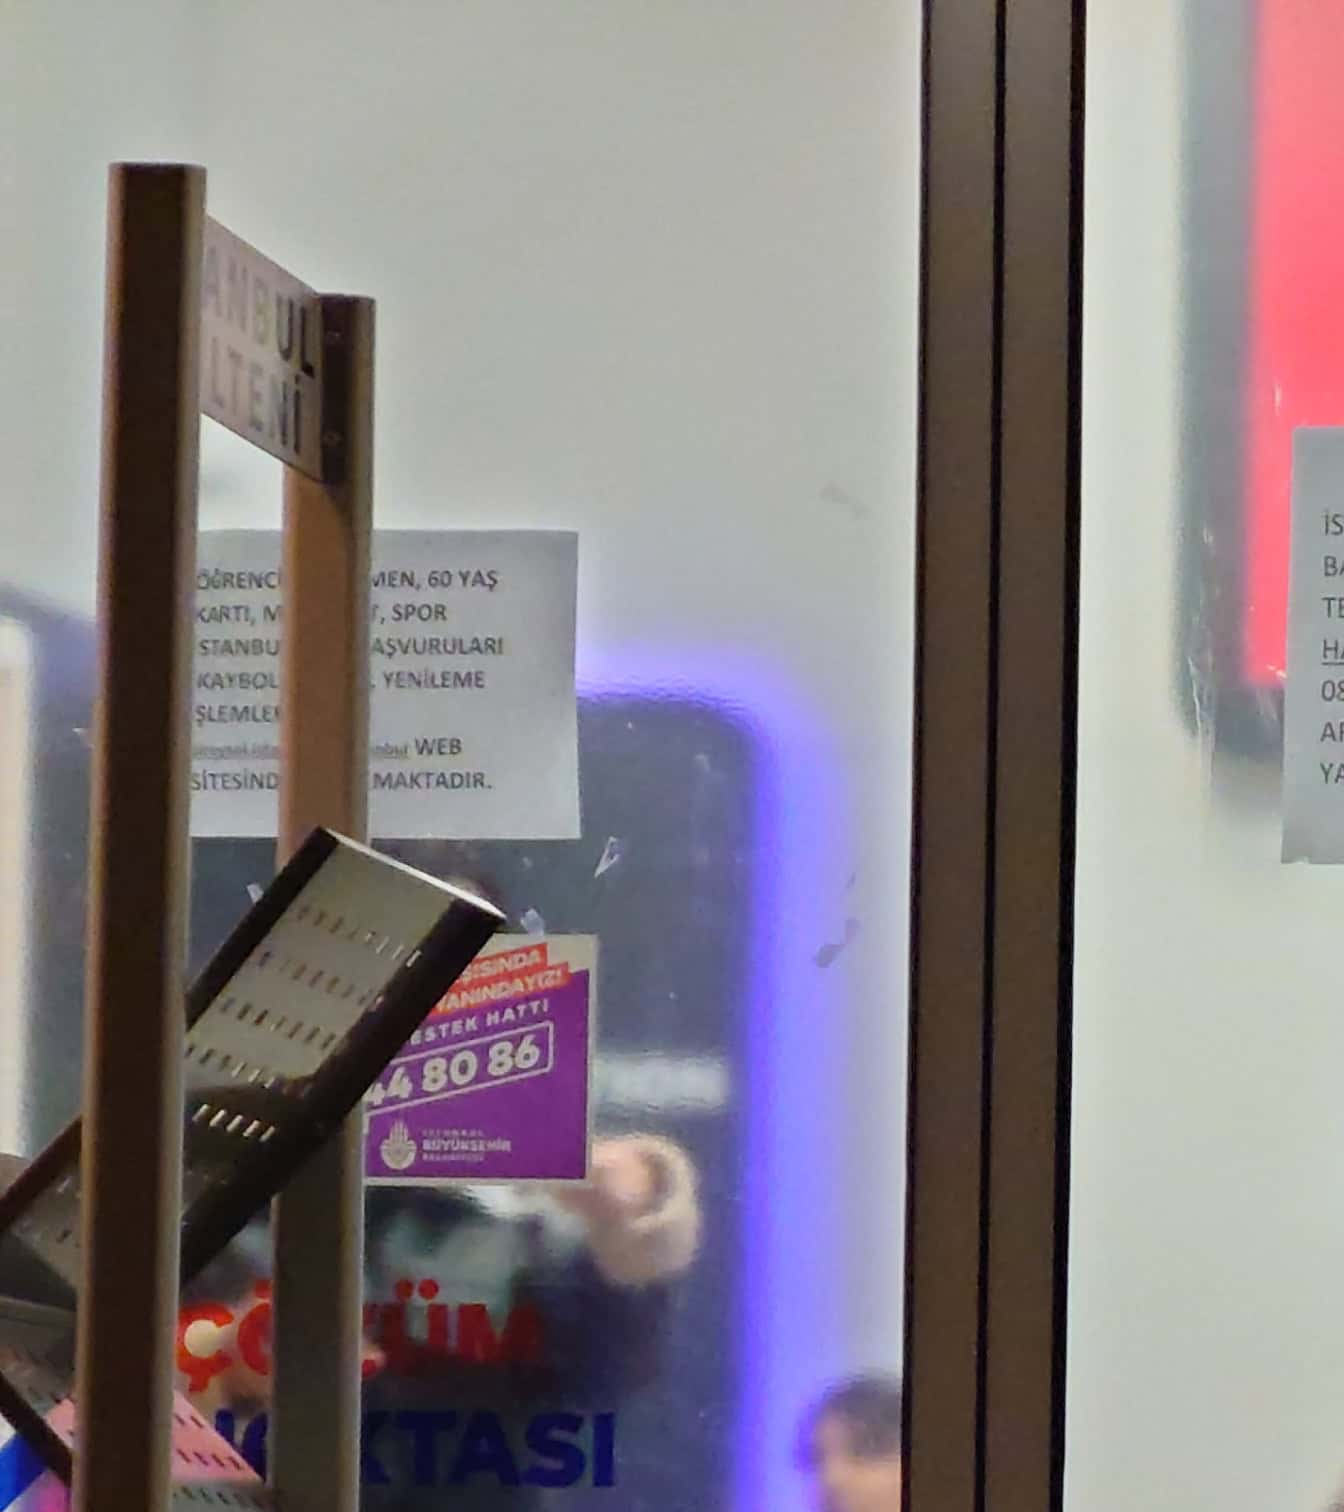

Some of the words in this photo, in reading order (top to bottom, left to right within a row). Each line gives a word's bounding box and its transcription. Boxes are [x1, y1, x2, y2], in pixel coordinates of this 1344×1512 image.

[203, 246, 315, 379] ANBUL
[211, 336, 301, 455] LTENİ
[197, 568, 281, 590] ÖĞRENC
[427, 569, 453, 589] 60
[459, 569, 499, 593] YAŞ
[391, 603, 448, 622] SPOR
[198, 638, 281, 657] STANBU
[371, 637, 505, 660] AŞVURULARI
[197, 671, 280, 690] KAYBOL
[383, 668, 487, 690] YENİLEME
[195, 704, 280, 728] ŞLEMLE
[415, 736, 463, 757] WEB
[191, 767, 280, 791] SİTESİND
[372, 770, 494, 790] MAKTADIR.
[410, 1016, 478, 1046] ESTEK
[486, 997, 549, 1028] HATTI
[421, 1050, 478, 1093] 80
[487, 1033, 541, 1077] 86
